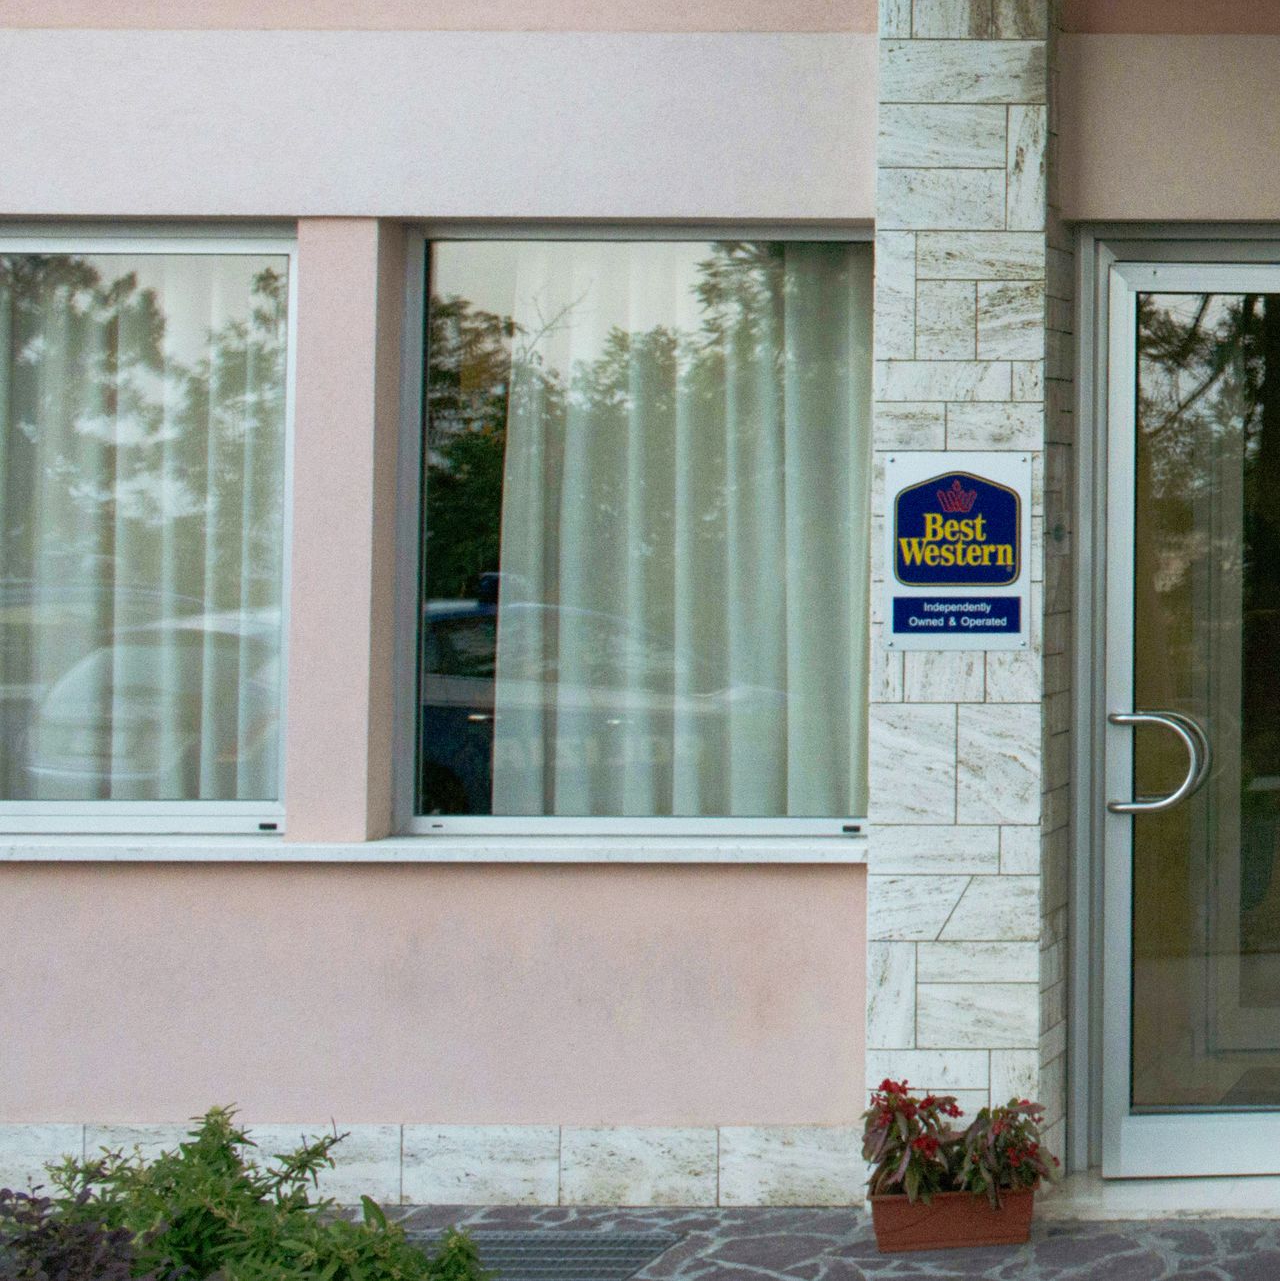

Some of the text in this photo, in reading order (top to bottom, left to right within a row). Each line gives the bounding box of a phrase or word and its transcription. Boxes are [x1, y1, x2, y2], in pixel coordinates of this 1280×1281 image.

[923, 512, 987, 542] Best
[899, 537, 1015, 567] Western
[923, 602, 992, 614] Independently
[909, 616, 1007, 628] Owned & Operated
